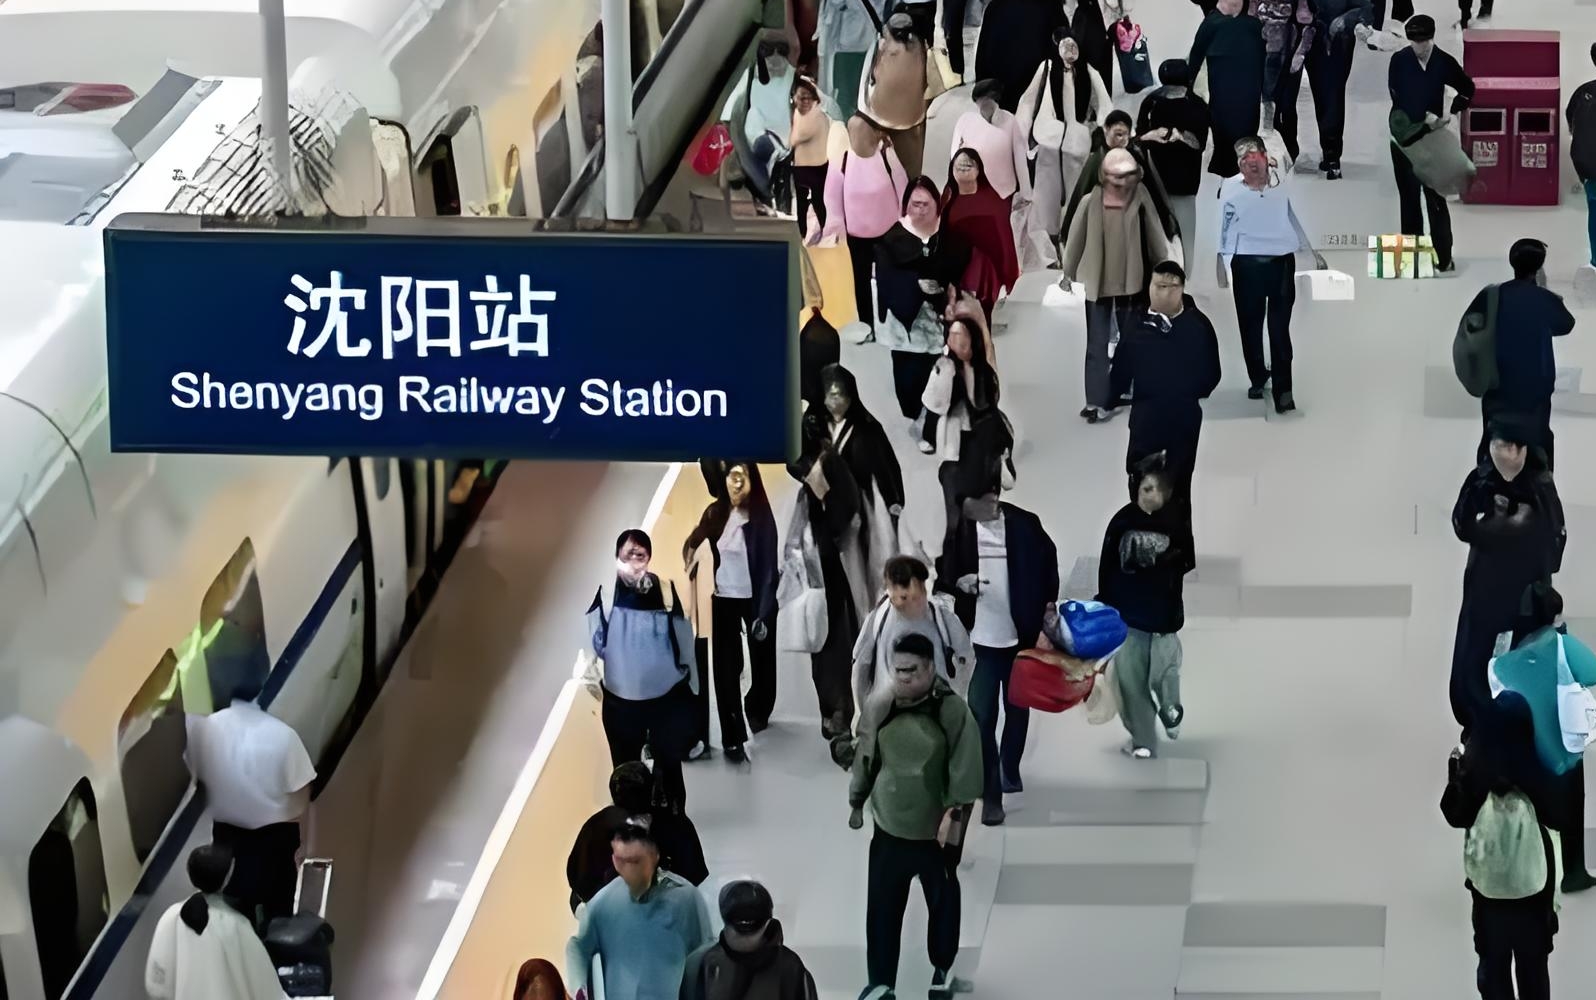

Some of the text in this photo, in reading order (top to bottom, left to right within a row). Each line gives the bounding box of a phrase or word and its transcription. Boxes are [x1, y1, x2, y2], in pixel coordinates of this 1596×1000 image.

[284, 271, 557, 360] 沈阳站
[172, 373, 728, 424] Shenyang Railway Station
